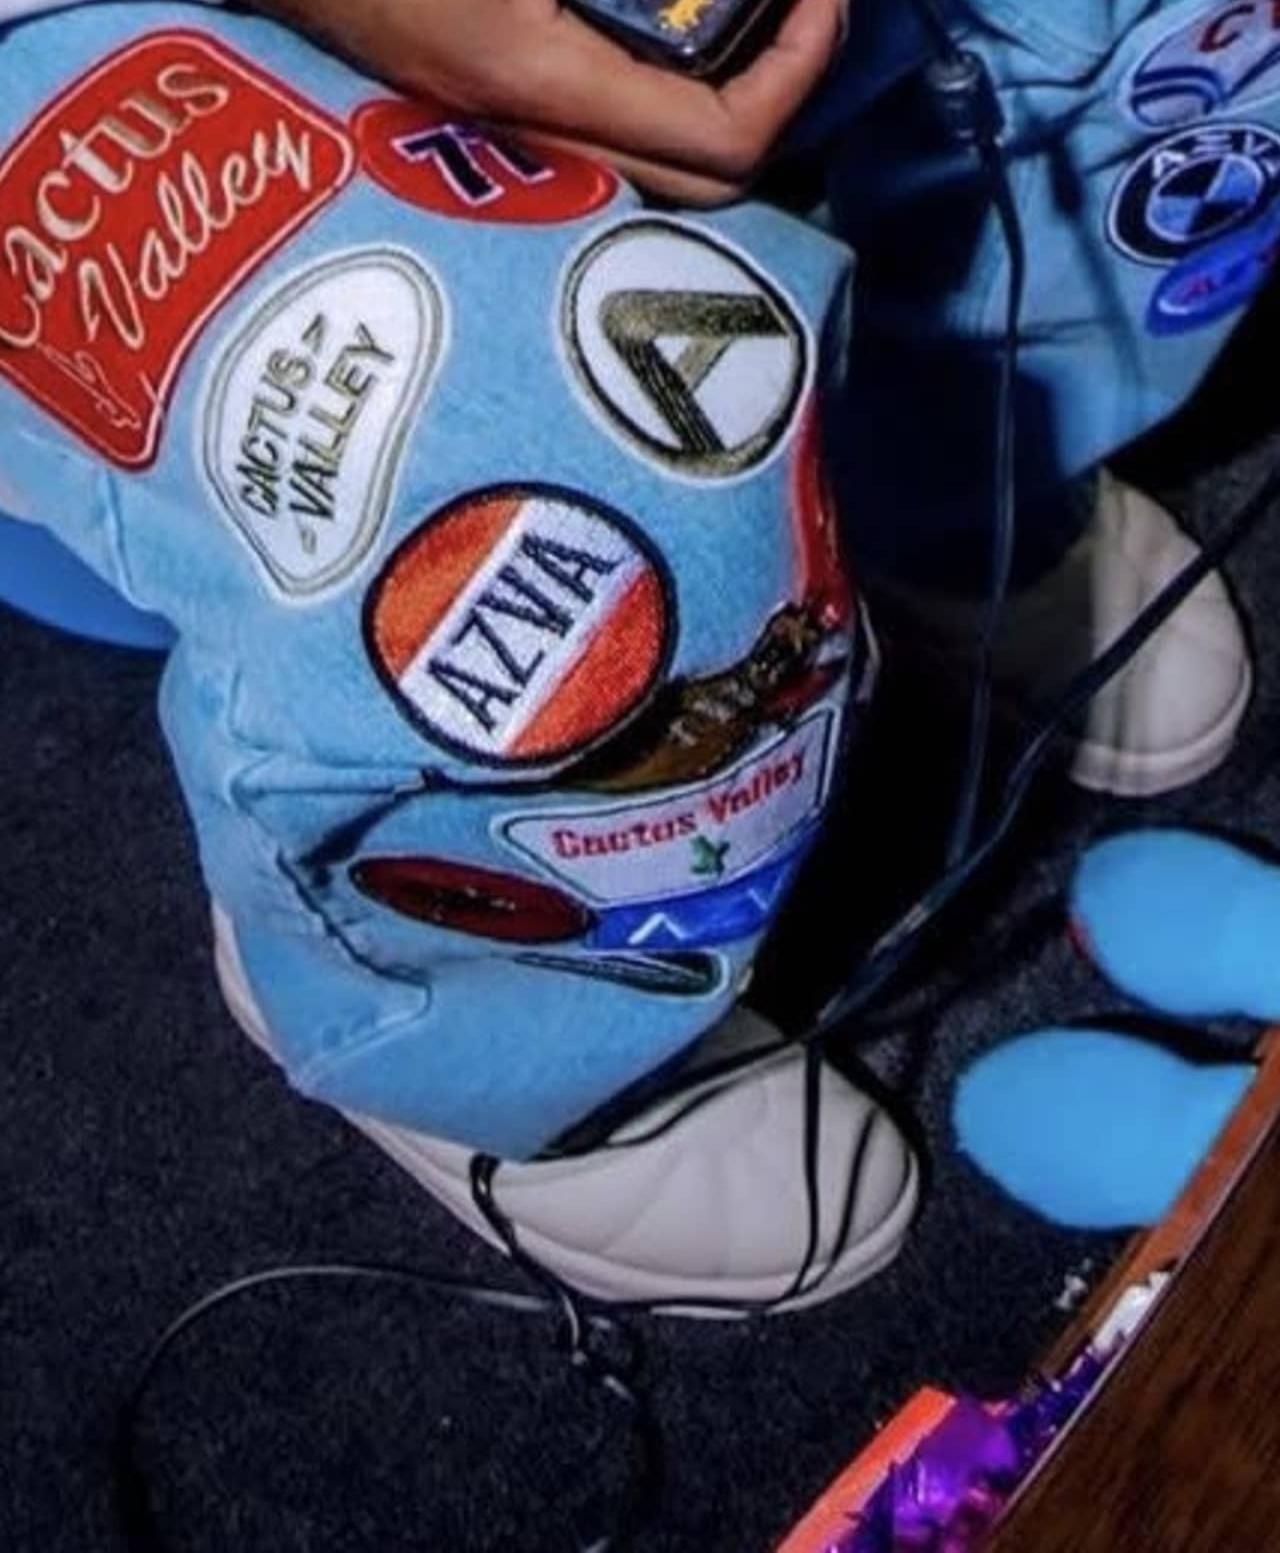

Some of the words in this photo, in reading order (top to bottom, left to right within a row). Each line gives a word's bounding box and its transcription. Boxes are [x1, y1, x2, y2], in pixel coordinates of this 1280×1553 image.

[77, 118, 312, 351] Valley
[235, 347, 314, 518] CACTUS
[286, 321, 396, 521] VALLEY
[426, 532, 617, 734] AZVA
[552, 812, 697, 860] Cactus
[705, 748, 806, 824] Valley
